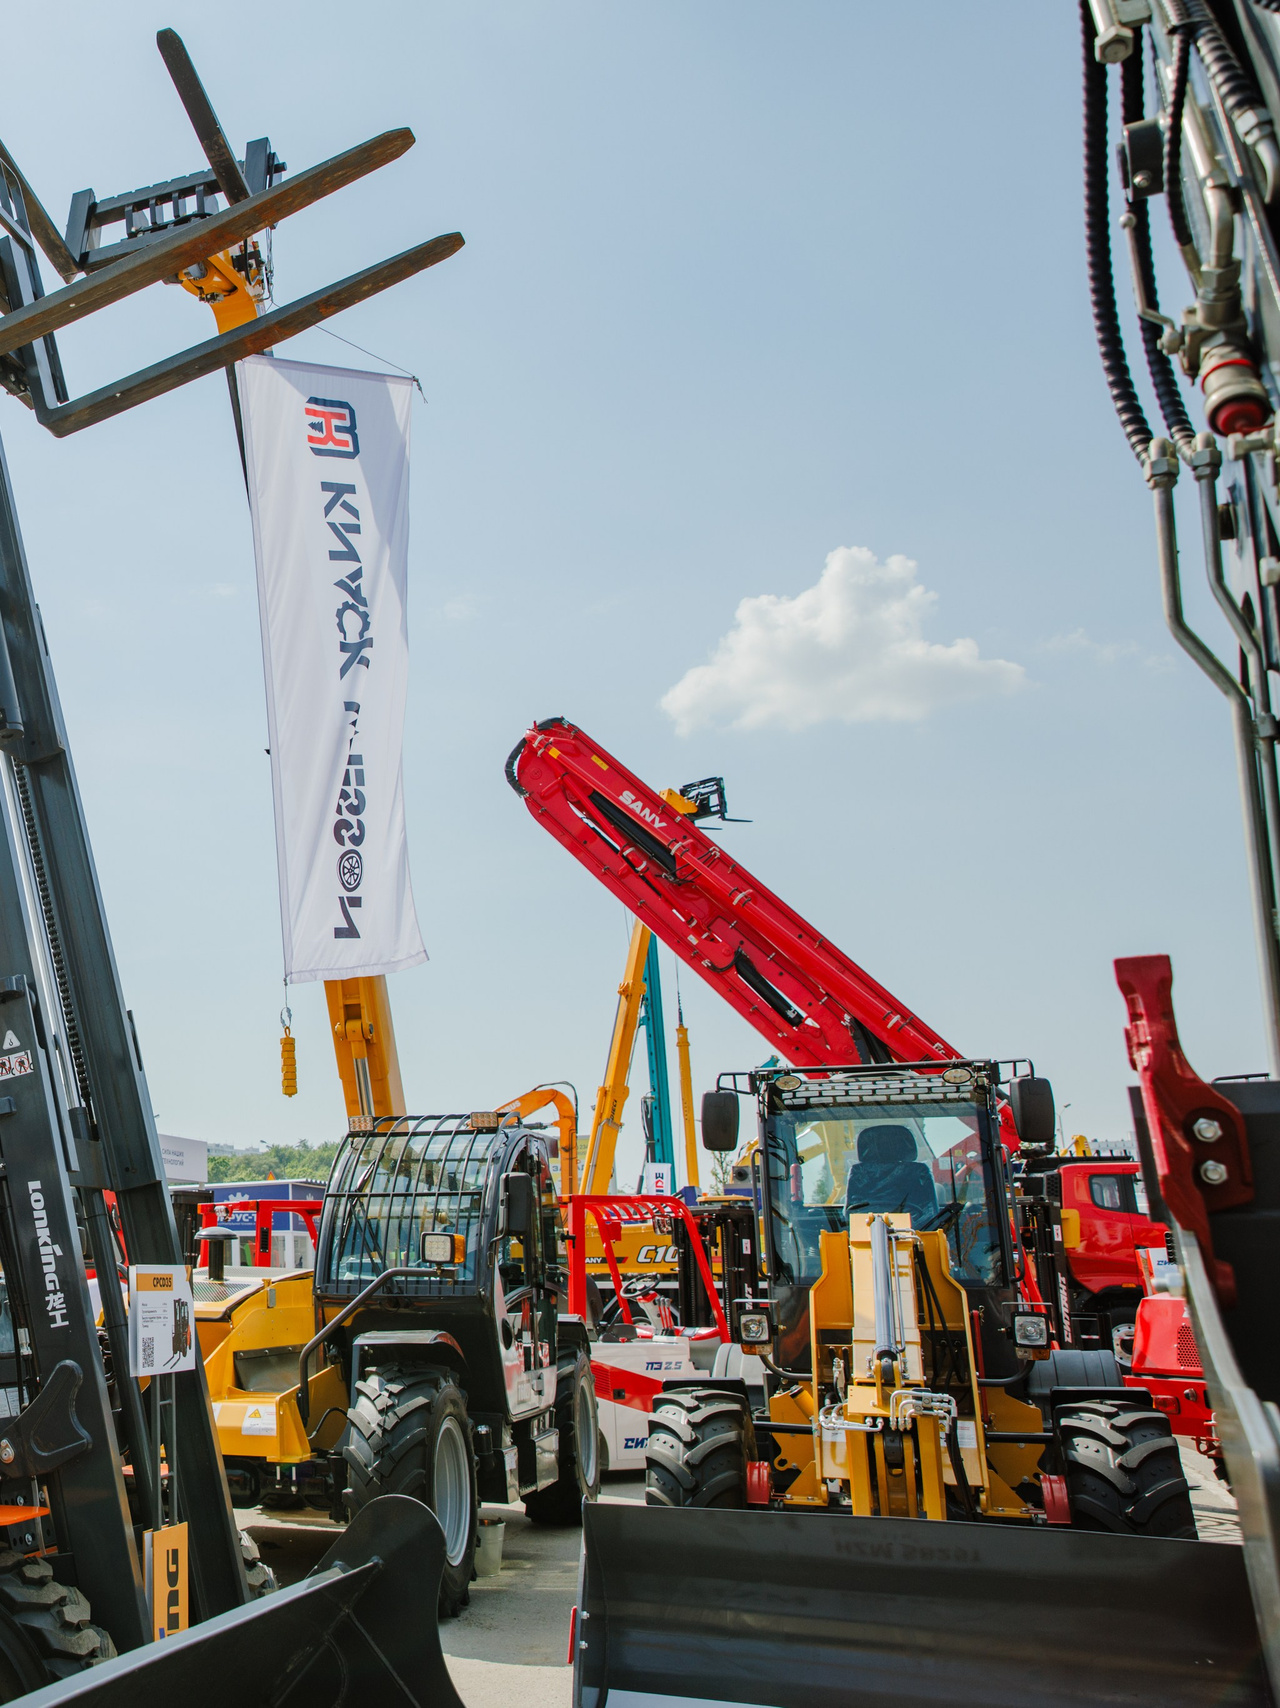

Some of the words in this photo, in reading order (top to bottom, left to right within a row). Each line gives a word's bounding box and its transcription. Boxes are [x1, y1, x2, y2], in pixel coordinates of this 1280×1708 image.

[618, 790, 667, 829] SANY
[27, 1181, 63, 1291] LONKING
[152, 1276, 172, 1288] CPCD35
[1057, 1272, 1072, 1344] СИЛАНТ
[663, 1361, 683, 1370] 2.5
